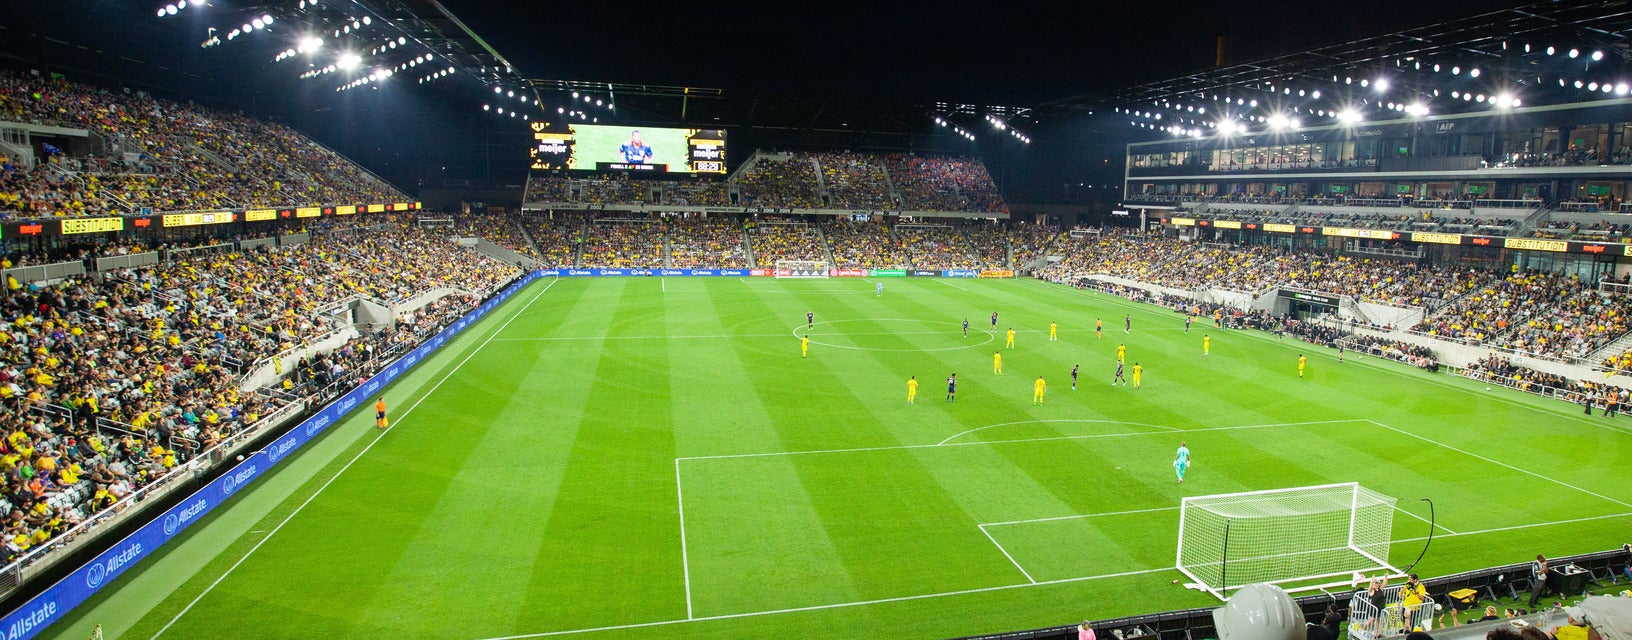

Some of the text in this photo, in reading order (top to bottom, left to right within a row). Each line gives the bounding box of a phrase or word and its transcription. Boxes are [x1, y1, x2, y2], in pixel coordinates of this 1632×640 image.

[539, 143, 567, 155] meijer
[693, 149, 719, 159] meijer
[64, 218, 121, 233] SUBSTITUTION
[1506, 239, 1565, 251] SUBSTITUTION
[314, 414, 330, 430] Allstate
[277, 436, 297, 456] Allstate
[234, 464, 257, 486] Allstate
[177, 498, 207, 526] Allstate
[105, 541, 142, 577] Allstate
[8, 600, 57, 640] Allstate
